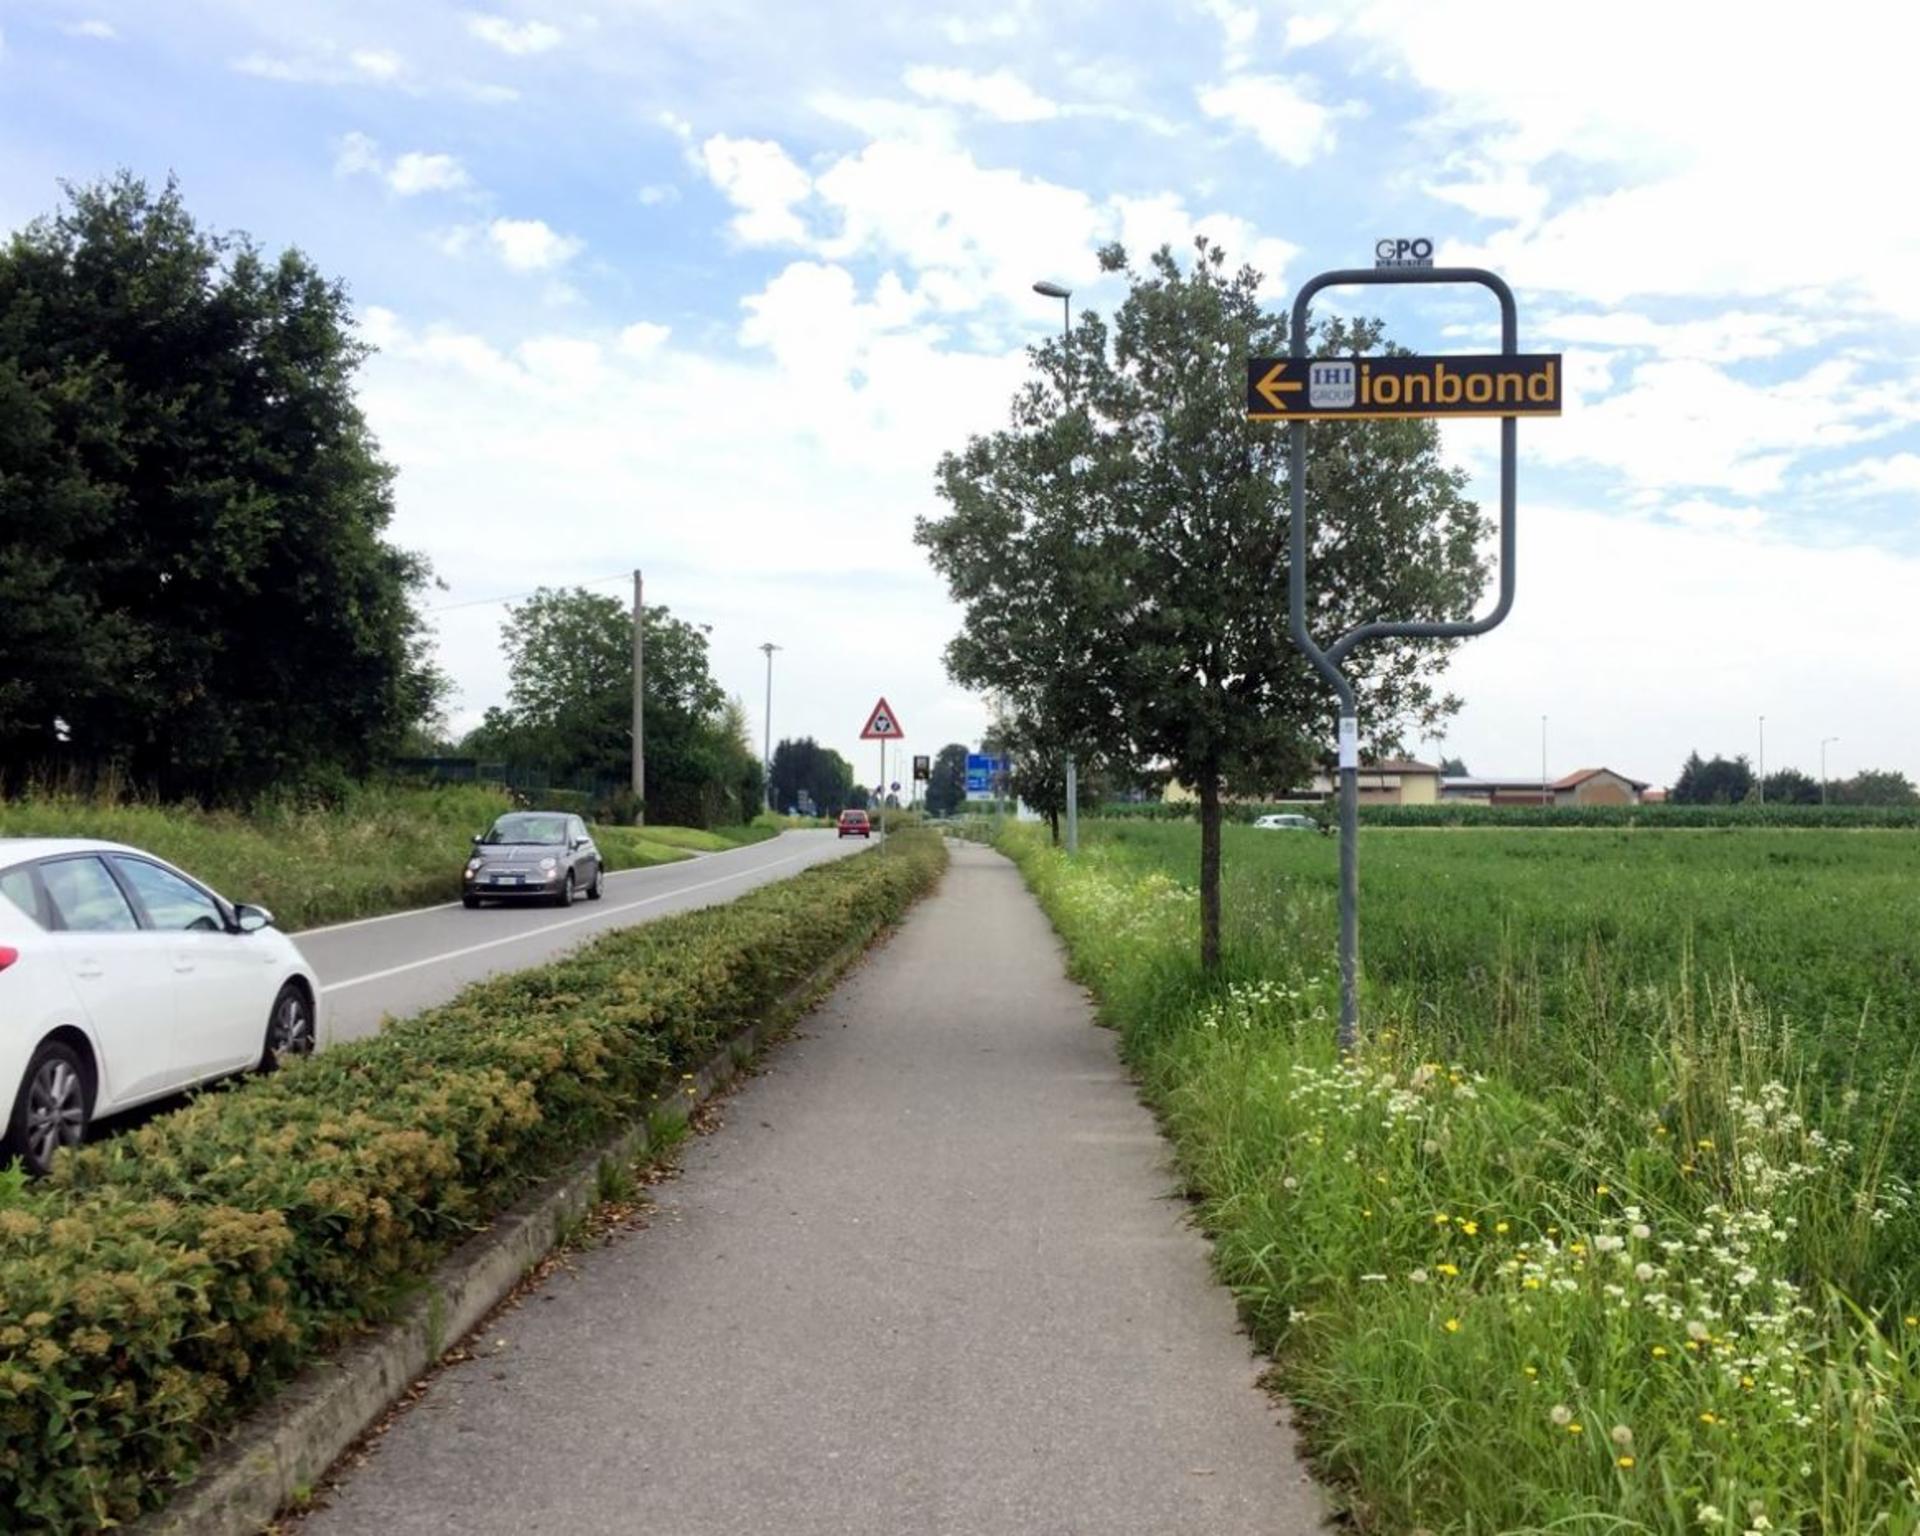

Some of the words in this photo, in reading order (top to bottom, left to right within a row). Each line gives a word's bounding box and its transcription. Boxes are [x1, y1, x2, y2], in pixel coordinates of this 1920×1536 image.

[1376, 238, 1433, 259] GPO
[1314, 369, 1351, 385] IHI
[1361, 362, 1555, 404] ionbond
[1312, 389, 1354, 401] GROUP
